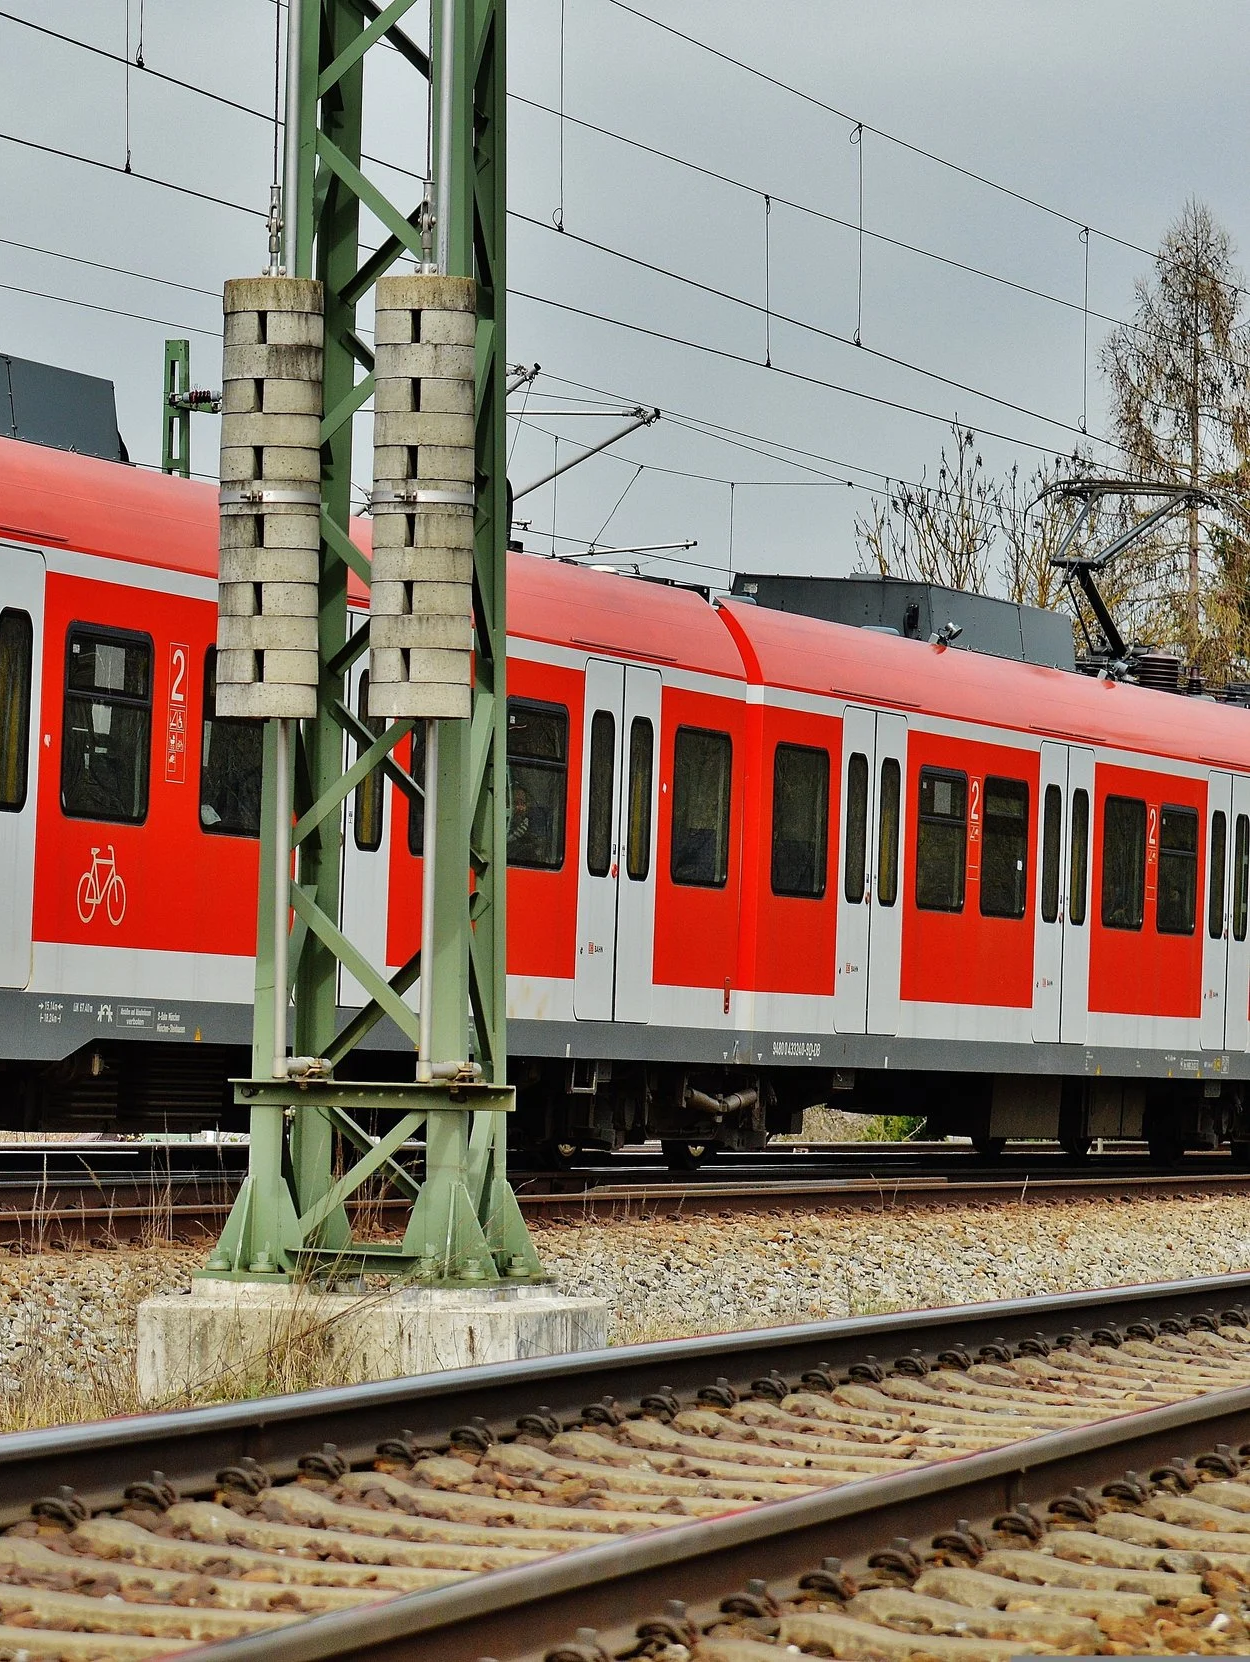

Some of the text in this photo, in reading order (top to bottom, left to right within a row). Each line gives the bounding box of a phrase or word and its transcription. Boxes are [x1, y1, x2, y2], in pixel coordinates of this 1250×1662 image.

[171, 648, 185, 702] 2
[971, 780, 980, 820] 2
[1148, 808, 1157, 845] 2
